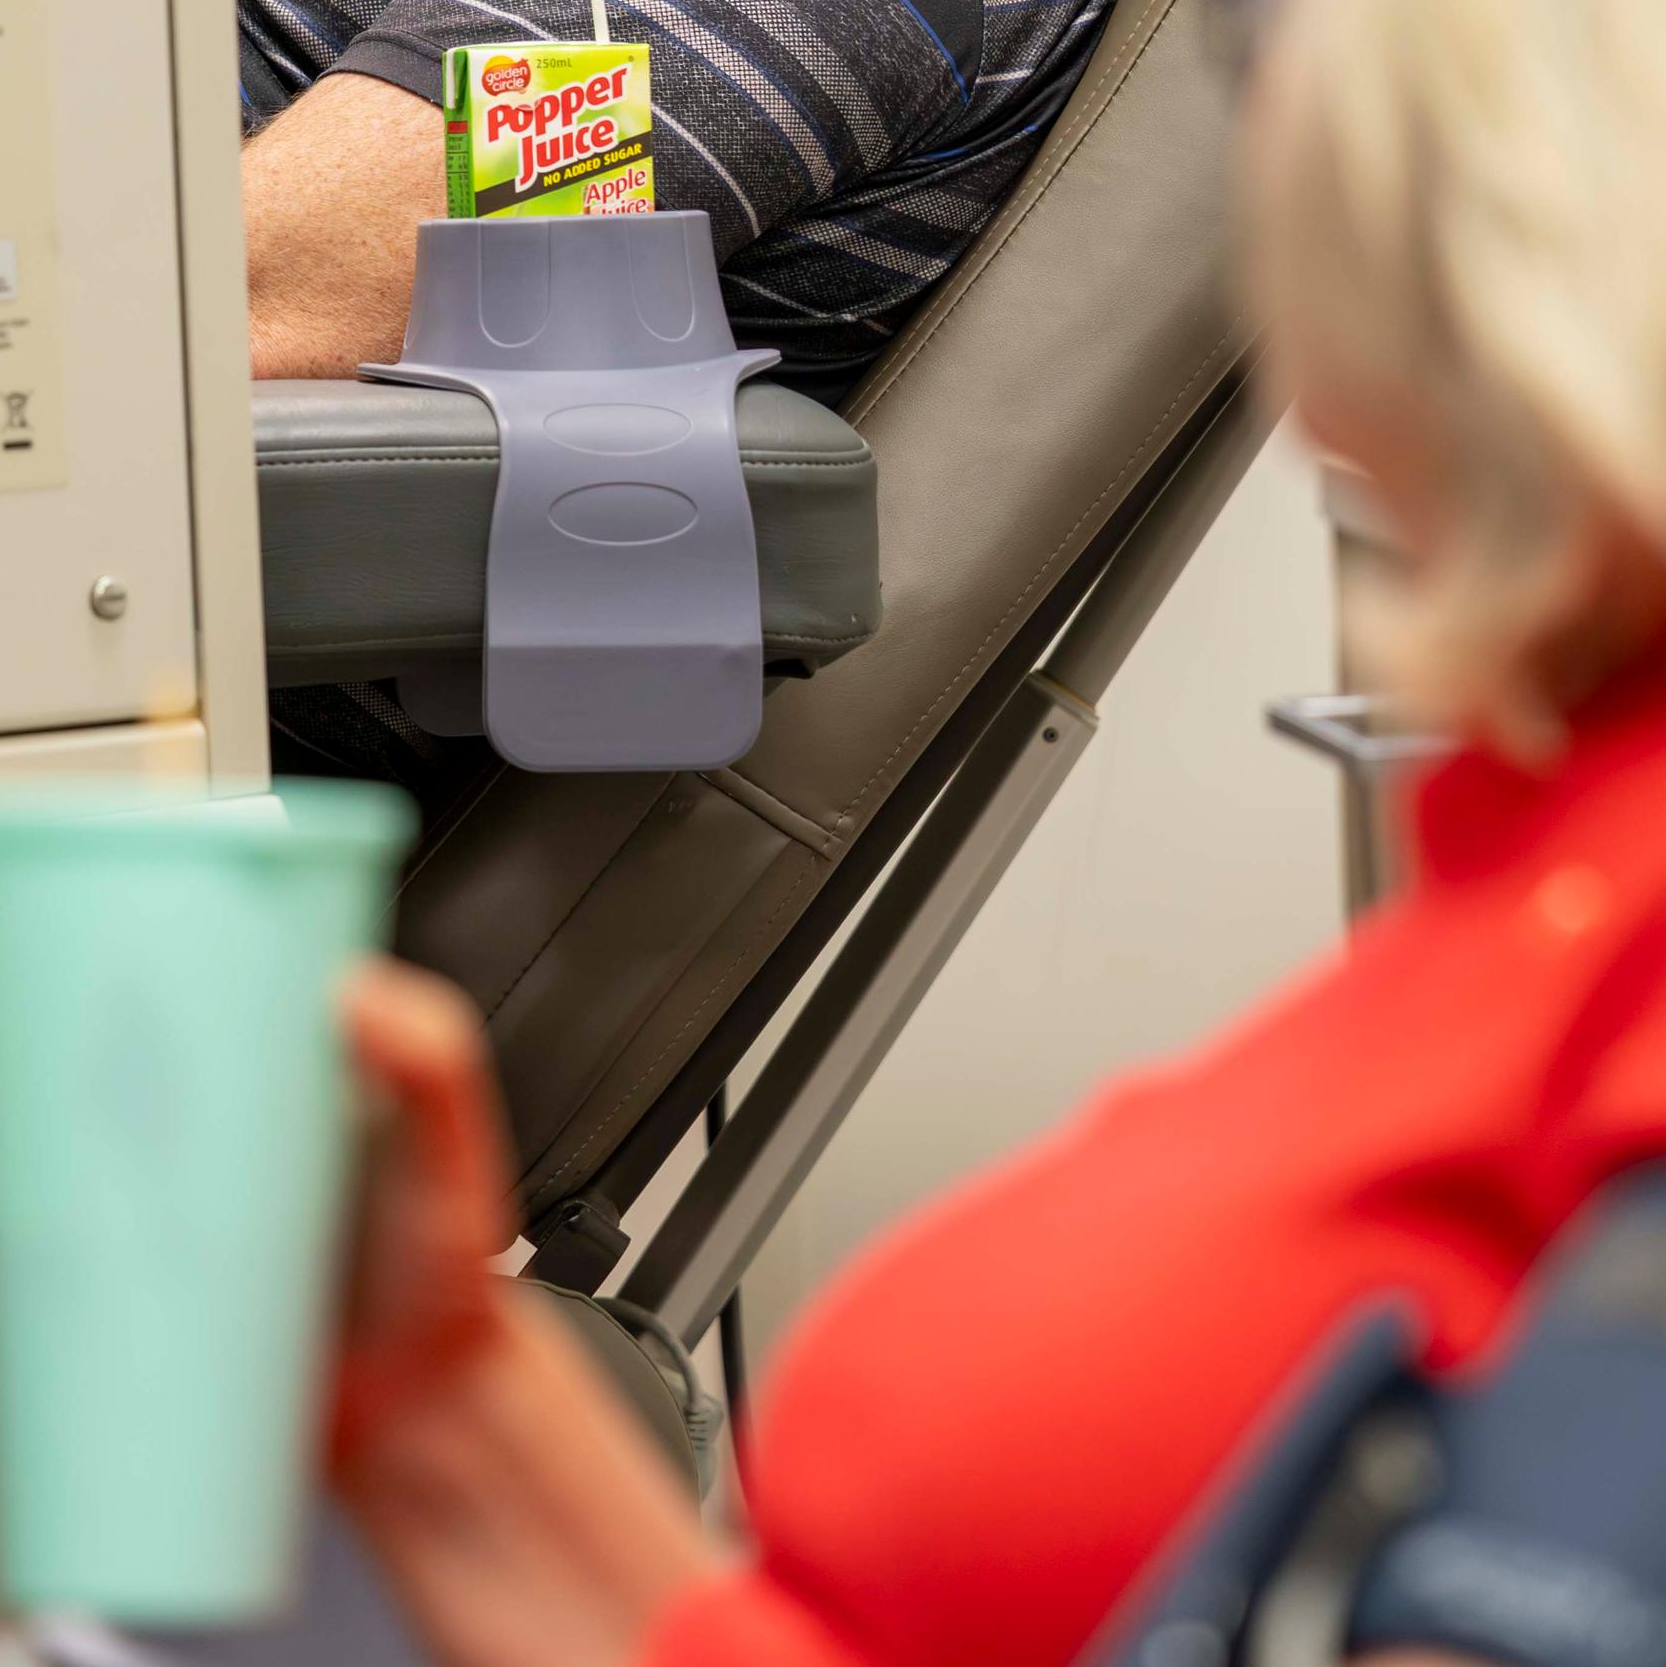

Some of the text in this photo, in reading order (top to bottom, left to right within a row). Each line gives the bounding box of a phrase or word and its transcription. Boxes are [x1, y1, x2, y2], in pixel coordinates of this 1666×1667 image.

[485, 66, 528, 86] golden
[492, 76, 525, 92] circle
[487, 67, 628, 142] Popper
[520, 119, 614, 186] Juice
[543, 143, 642, 187] NO ADDED SUGAR
[587, 168, 646, 205] Apple
